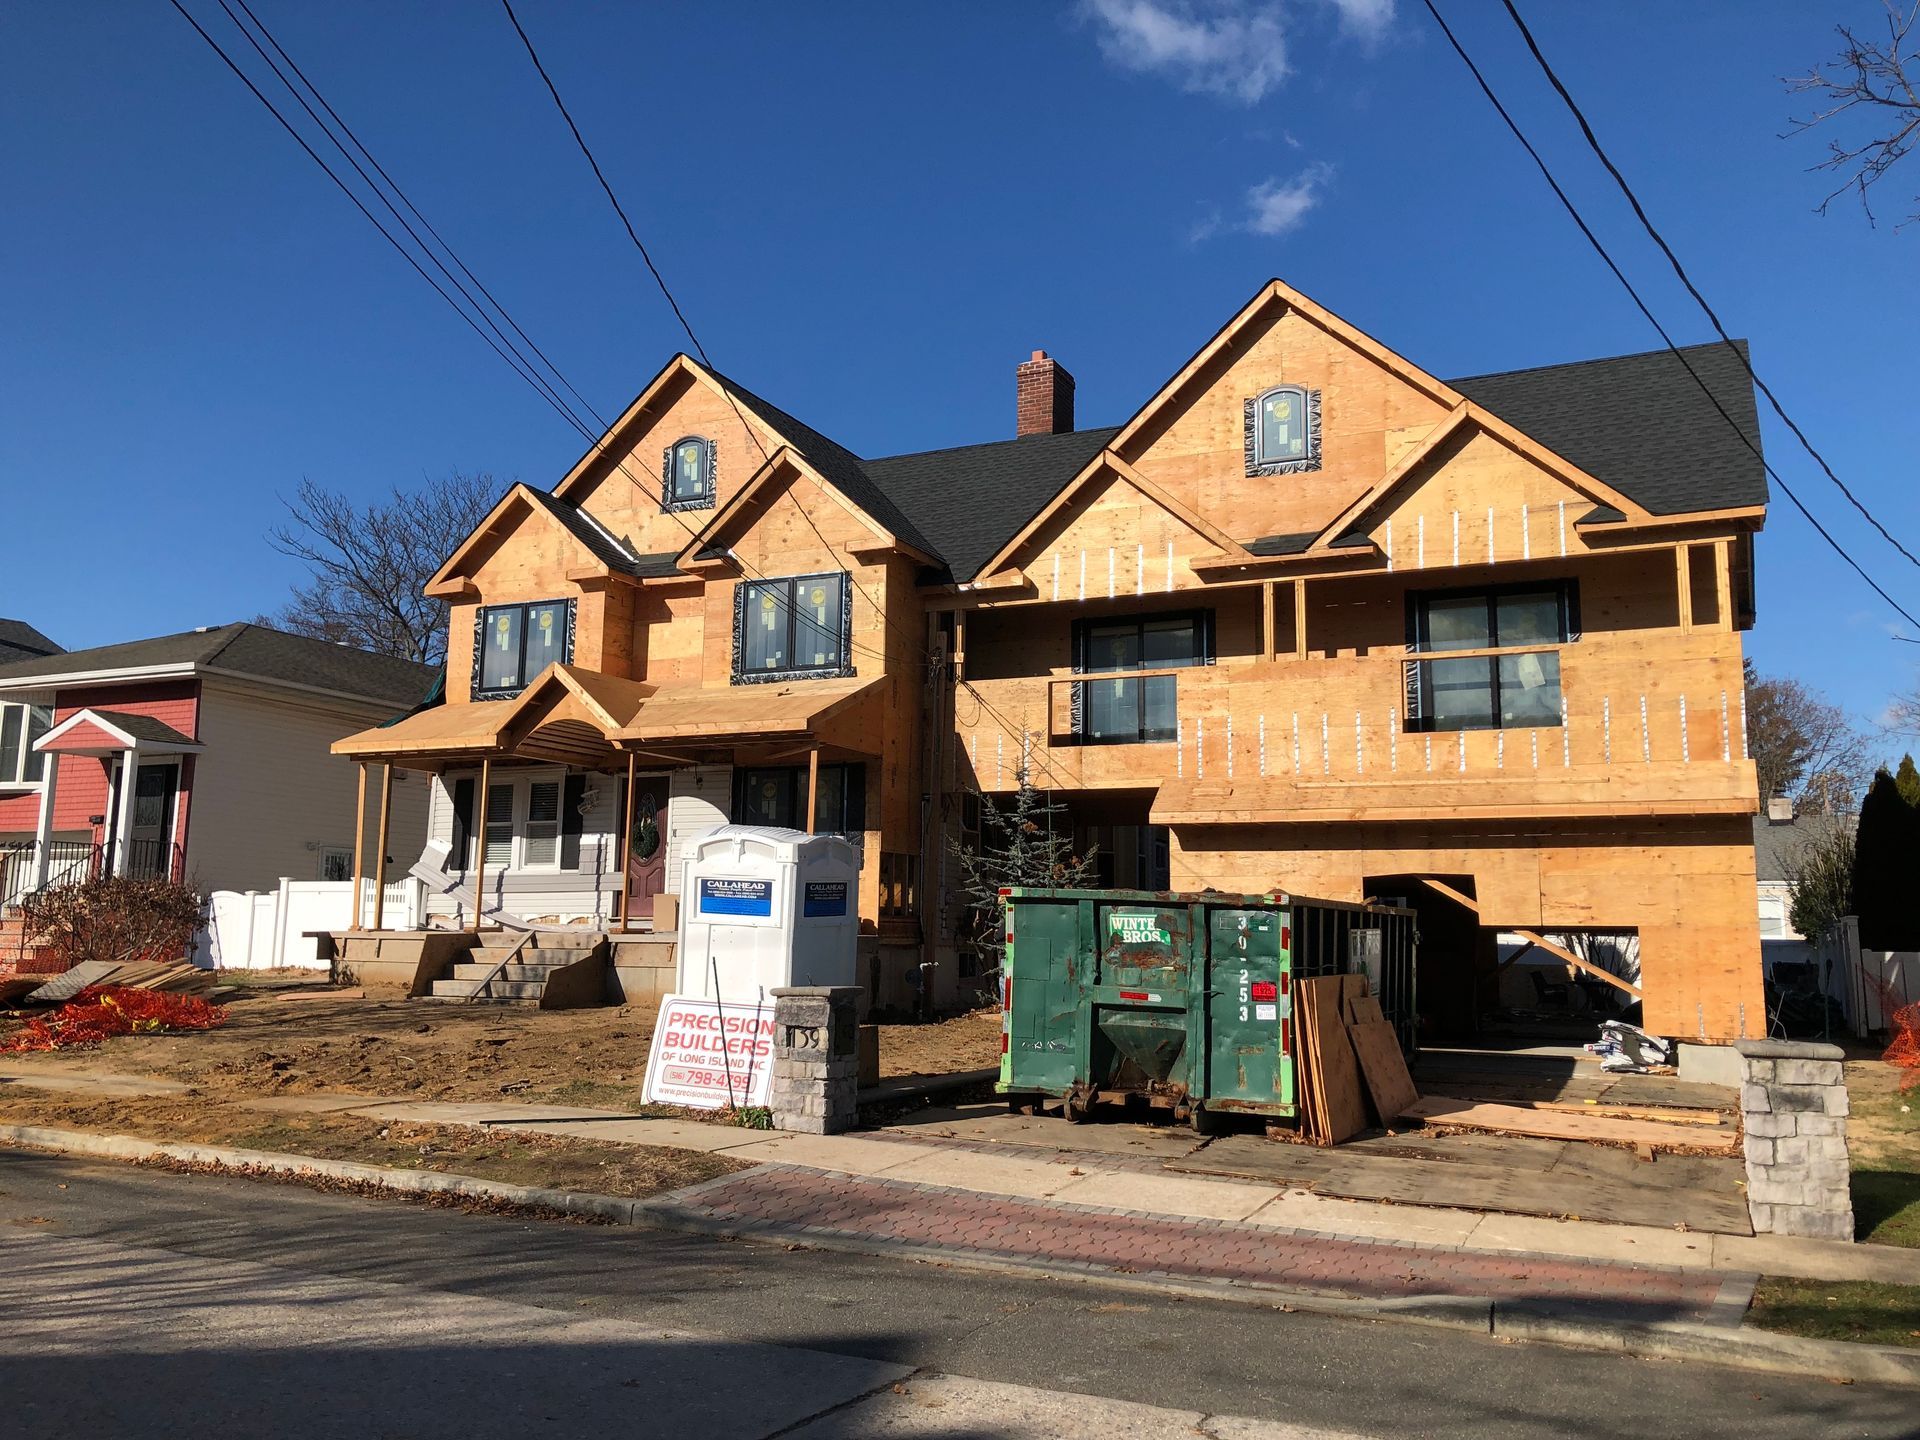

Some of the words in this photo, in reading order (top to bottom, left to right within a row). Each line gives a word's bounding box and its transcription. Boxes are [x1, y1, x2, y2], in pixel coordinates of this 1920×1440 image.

[707, 880, 766, 890] CALLAHEAD
[1111, 917, 1161, 930] WINTE
[1122, 930, 1164, 943] BROS.
[668, 1012, 776, 1036] PRECISION
[663, 1032, 770, 1056] BUILDERS
[661, 1051, 676, 1061] OF
[679, 1053, 706, 1064] LONG
[749, 1059, 766, 1070] NC
[669, 1071, 685, 1080] (516)
[685, 1070, 750, 1089] 798-4799
